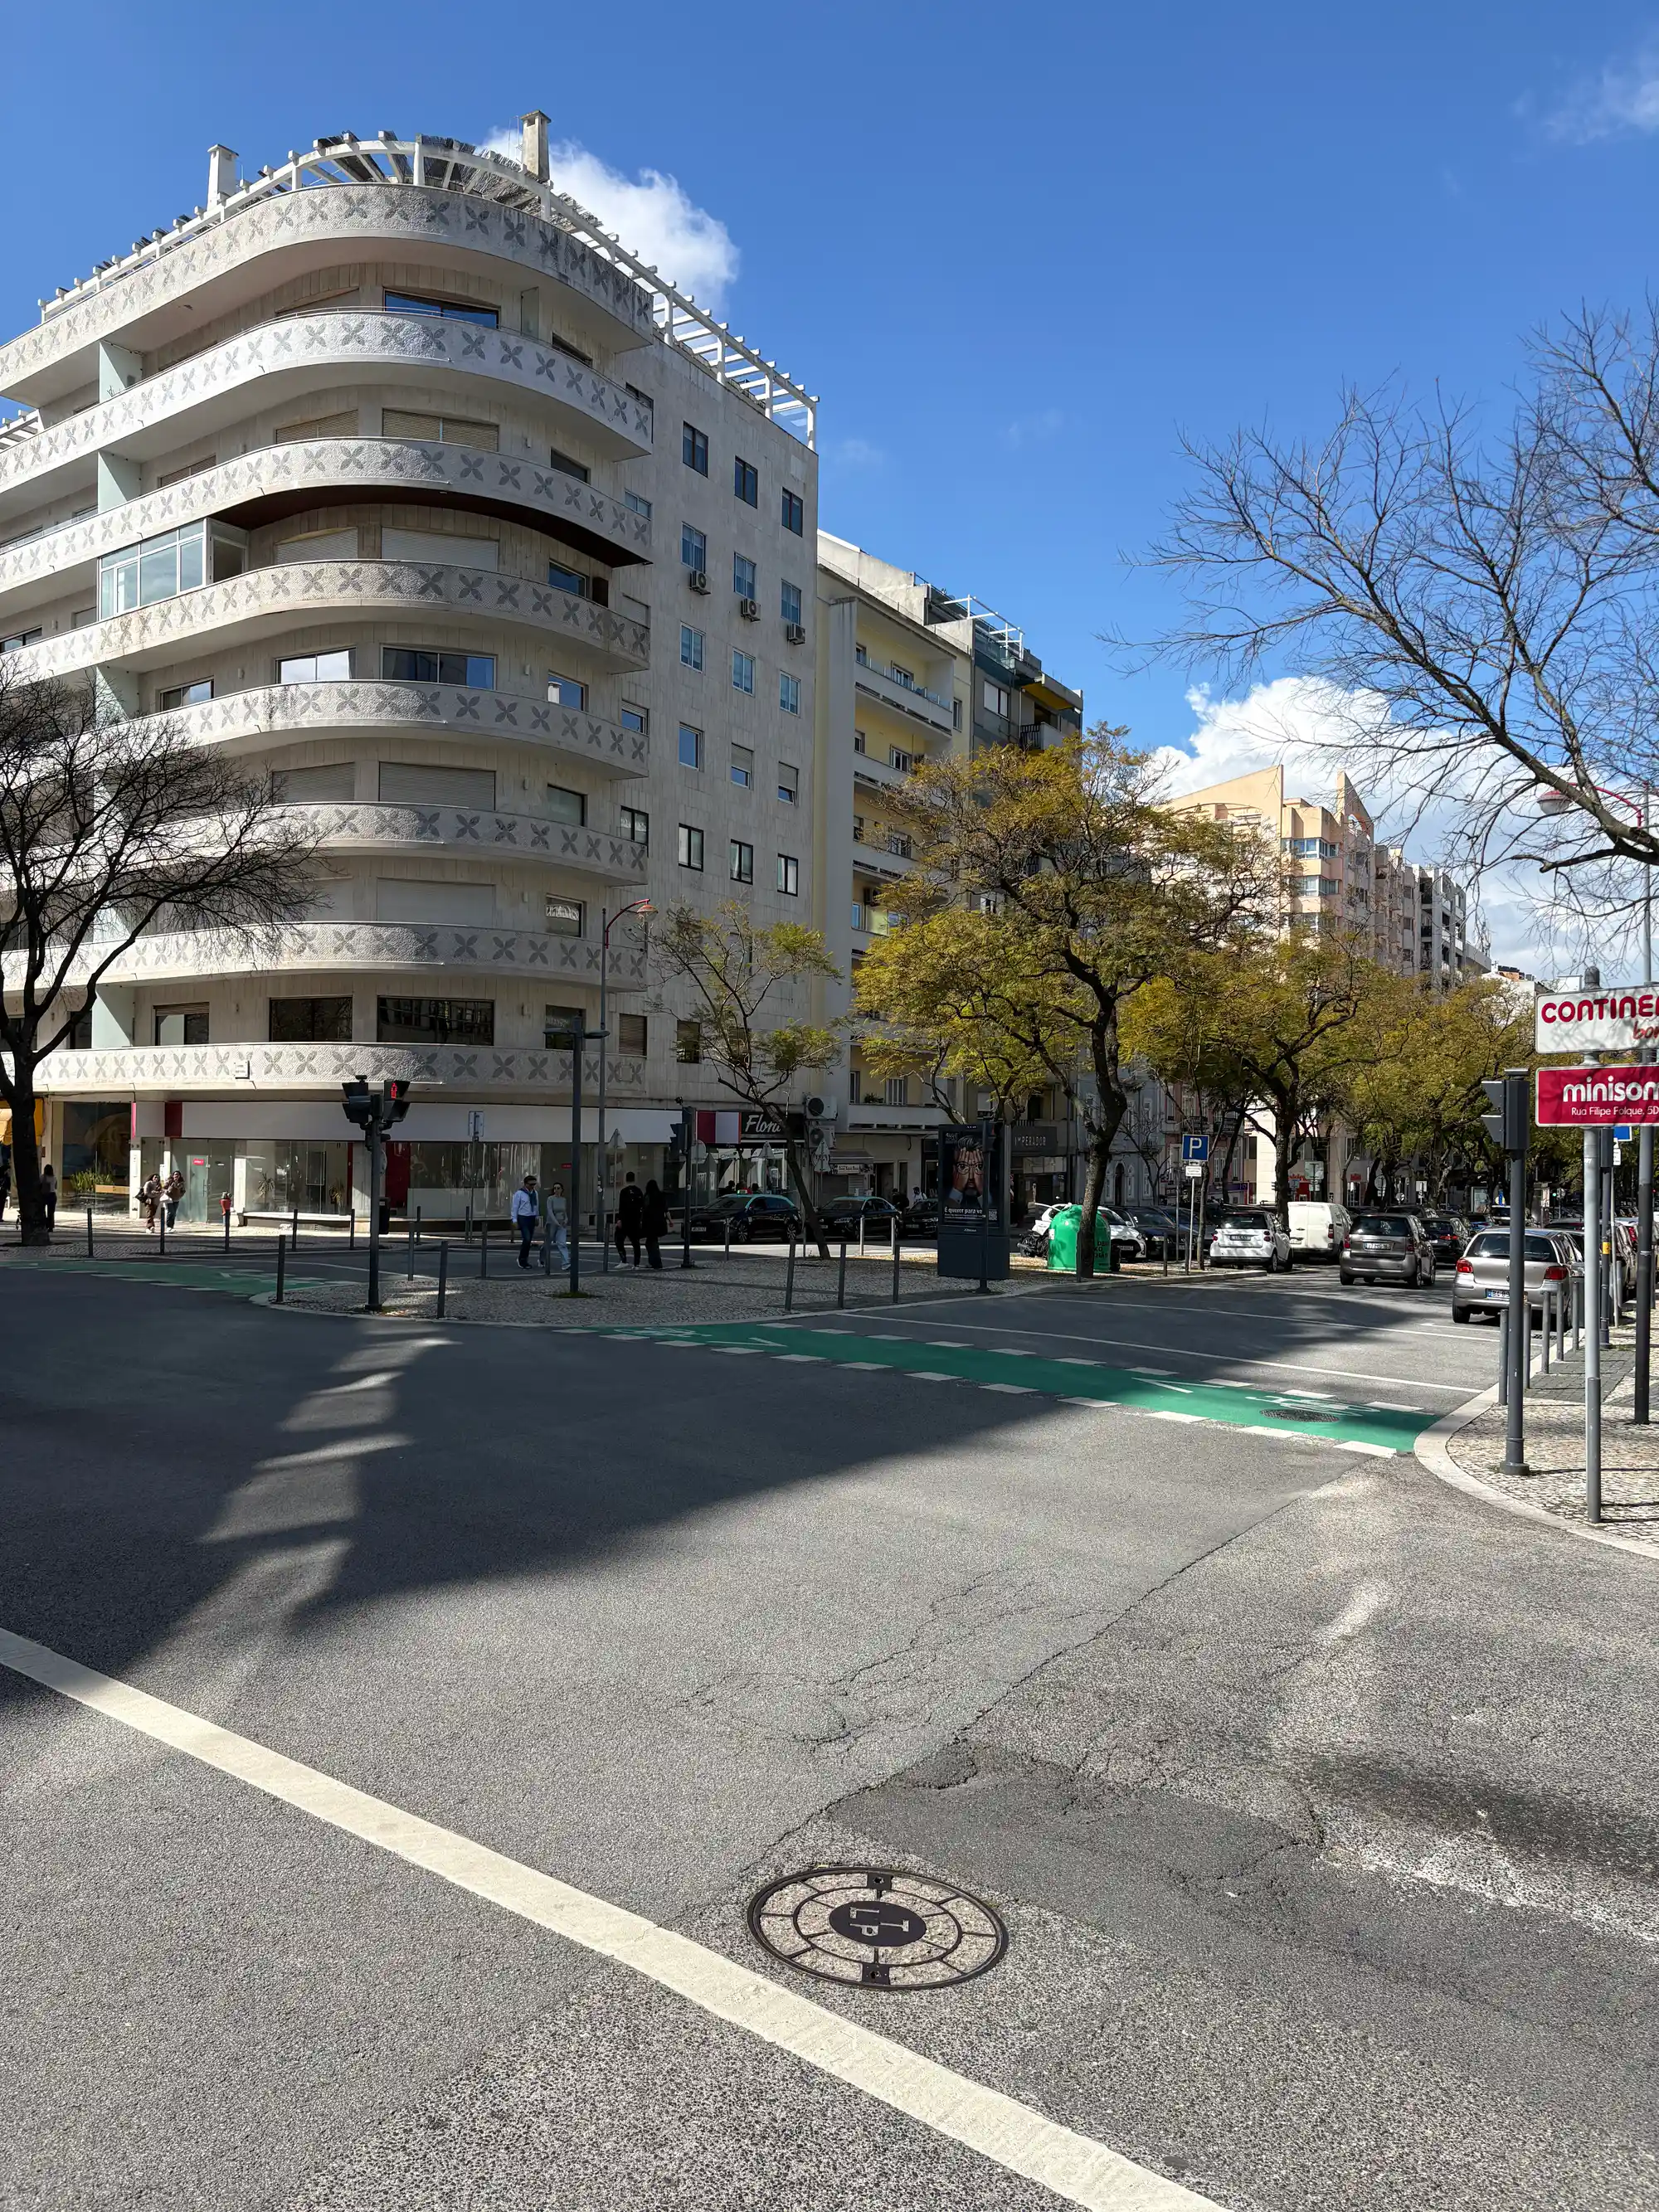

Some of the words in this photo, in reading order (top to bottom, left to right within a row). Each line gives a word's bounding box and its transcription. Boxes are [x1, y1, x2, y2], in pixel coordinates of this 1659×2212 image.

[1541, 994, 1659, 1023] CONTINE
[1571, 1107, 1587, 1116] Rua
[1589, 1106, 1611, 1117] Filipe
[1613, 1106, 1645, 1117] Folque,
[1190, 1137, 1202, 1158] P
